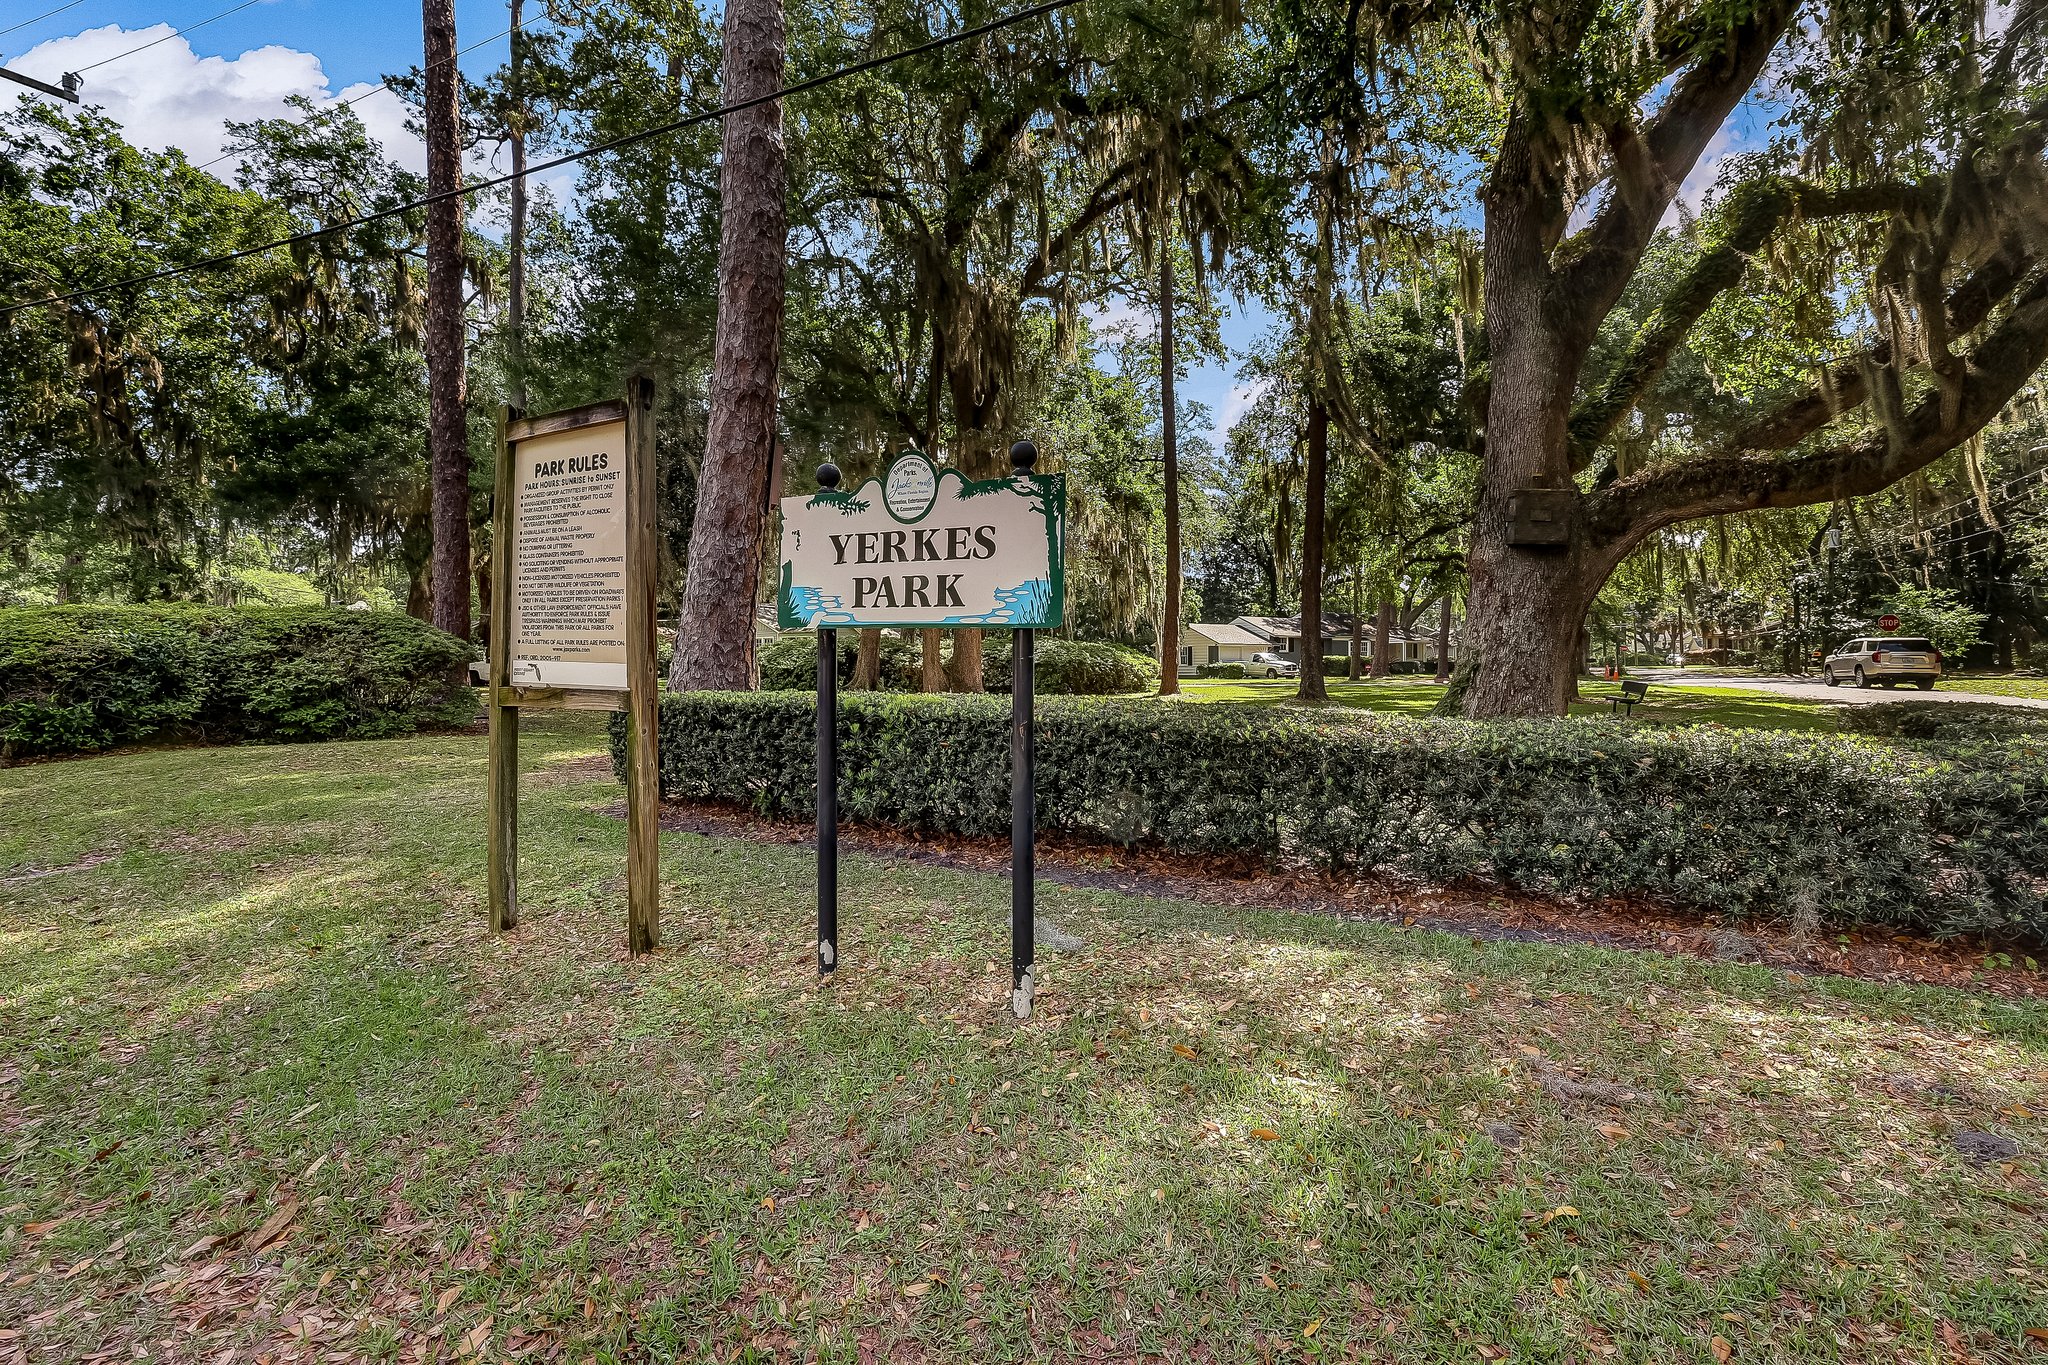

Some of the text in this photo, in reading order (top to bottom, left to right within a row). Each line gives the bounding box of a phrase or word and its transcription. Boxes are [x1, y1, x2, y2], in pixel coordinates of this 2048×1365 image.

[535, 453, 608, 478] PARK RULES
[893, 462, 922, 475] Department
[562, 476, 586, 486] SUNRISE
[596, 472, 620, 481] SUNSET
[524, 492, 545, 500] ORGANIZED
[560, 487, 580, 495] ACTIVITIES
[829, 526, 996, 565] YERKES
[851, 574, 965, 608] PARK
